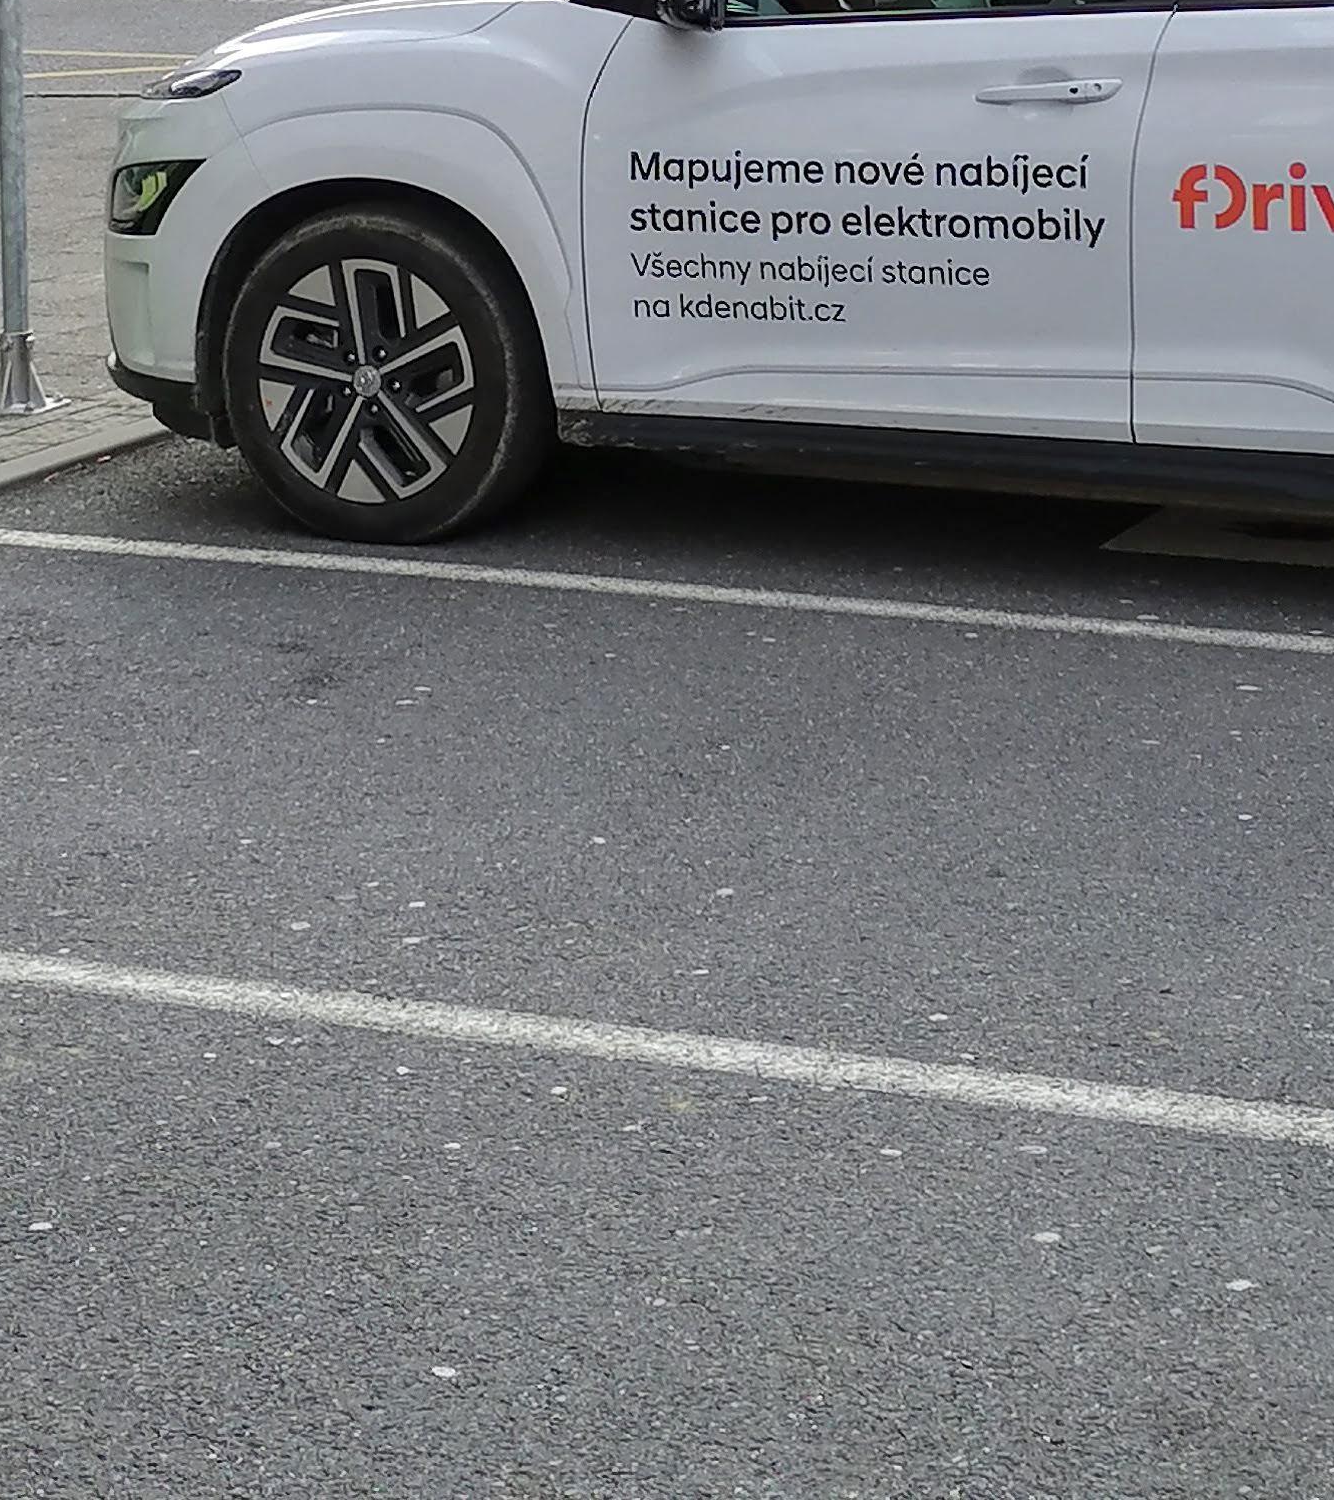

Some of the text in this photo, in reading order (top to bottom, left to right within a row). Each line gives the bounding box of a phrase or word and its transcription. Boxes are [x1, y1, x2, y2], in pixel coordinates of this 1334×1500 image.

[629, 150, 1089, 196] Mapujeme nové nabíjecí
[629, 201, 1106, 249] stanice pro elektromobily
[630, 250, 991, 288] Všechny nabíjecí stanice
[633, 293, 847, 323] na kdenabit.cz
